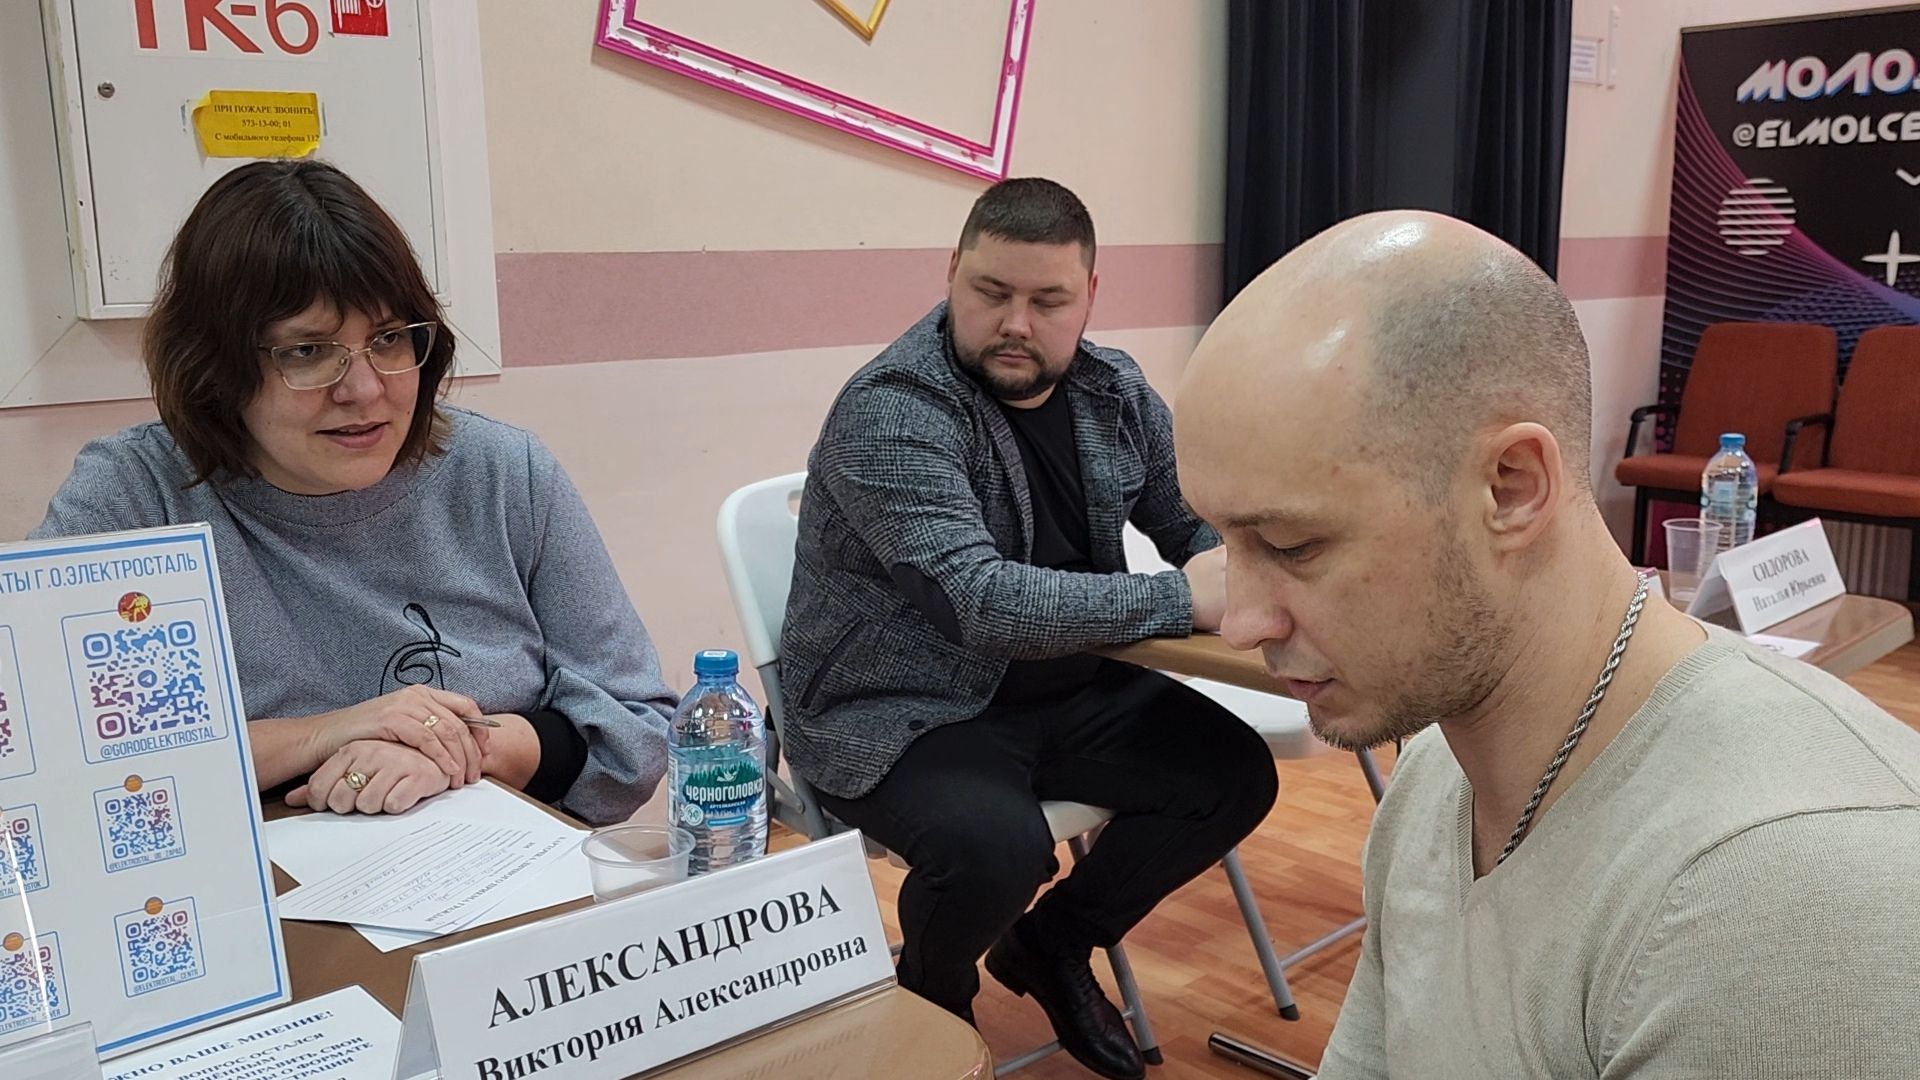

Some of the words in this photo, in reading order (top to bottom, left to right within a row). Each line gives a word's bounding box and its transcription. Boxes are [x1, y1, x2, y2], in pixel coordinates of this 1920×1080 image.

[1737, 49, 1920, 102] МОЛО
[214, 105, 232, 113] ПРИ
[235, 105, 271, 114] ПОЖАРЕ
[283, 120, 291, 128] 01
[224, 133, 269, 142] мобильного
[271, 134, 305, 143] телефона
[100, 726, 216, 759] @GORODELEKTROSTAL
[487, 883, 842, 1029] АЛЕКСАНДРОВА
[474, 1012, 645, 1080] Виктория
[654, 935, 868, 1029] Александровна
[169, 1041, 234, 1066] ВАШЕ
[238, 1010, 333, 1045] МНЕНИЕ!
[249, 1032, 324, 1060] ОСТАЛСЯ
[296, 1042, 374, 1070] ФОРМАТЕ
